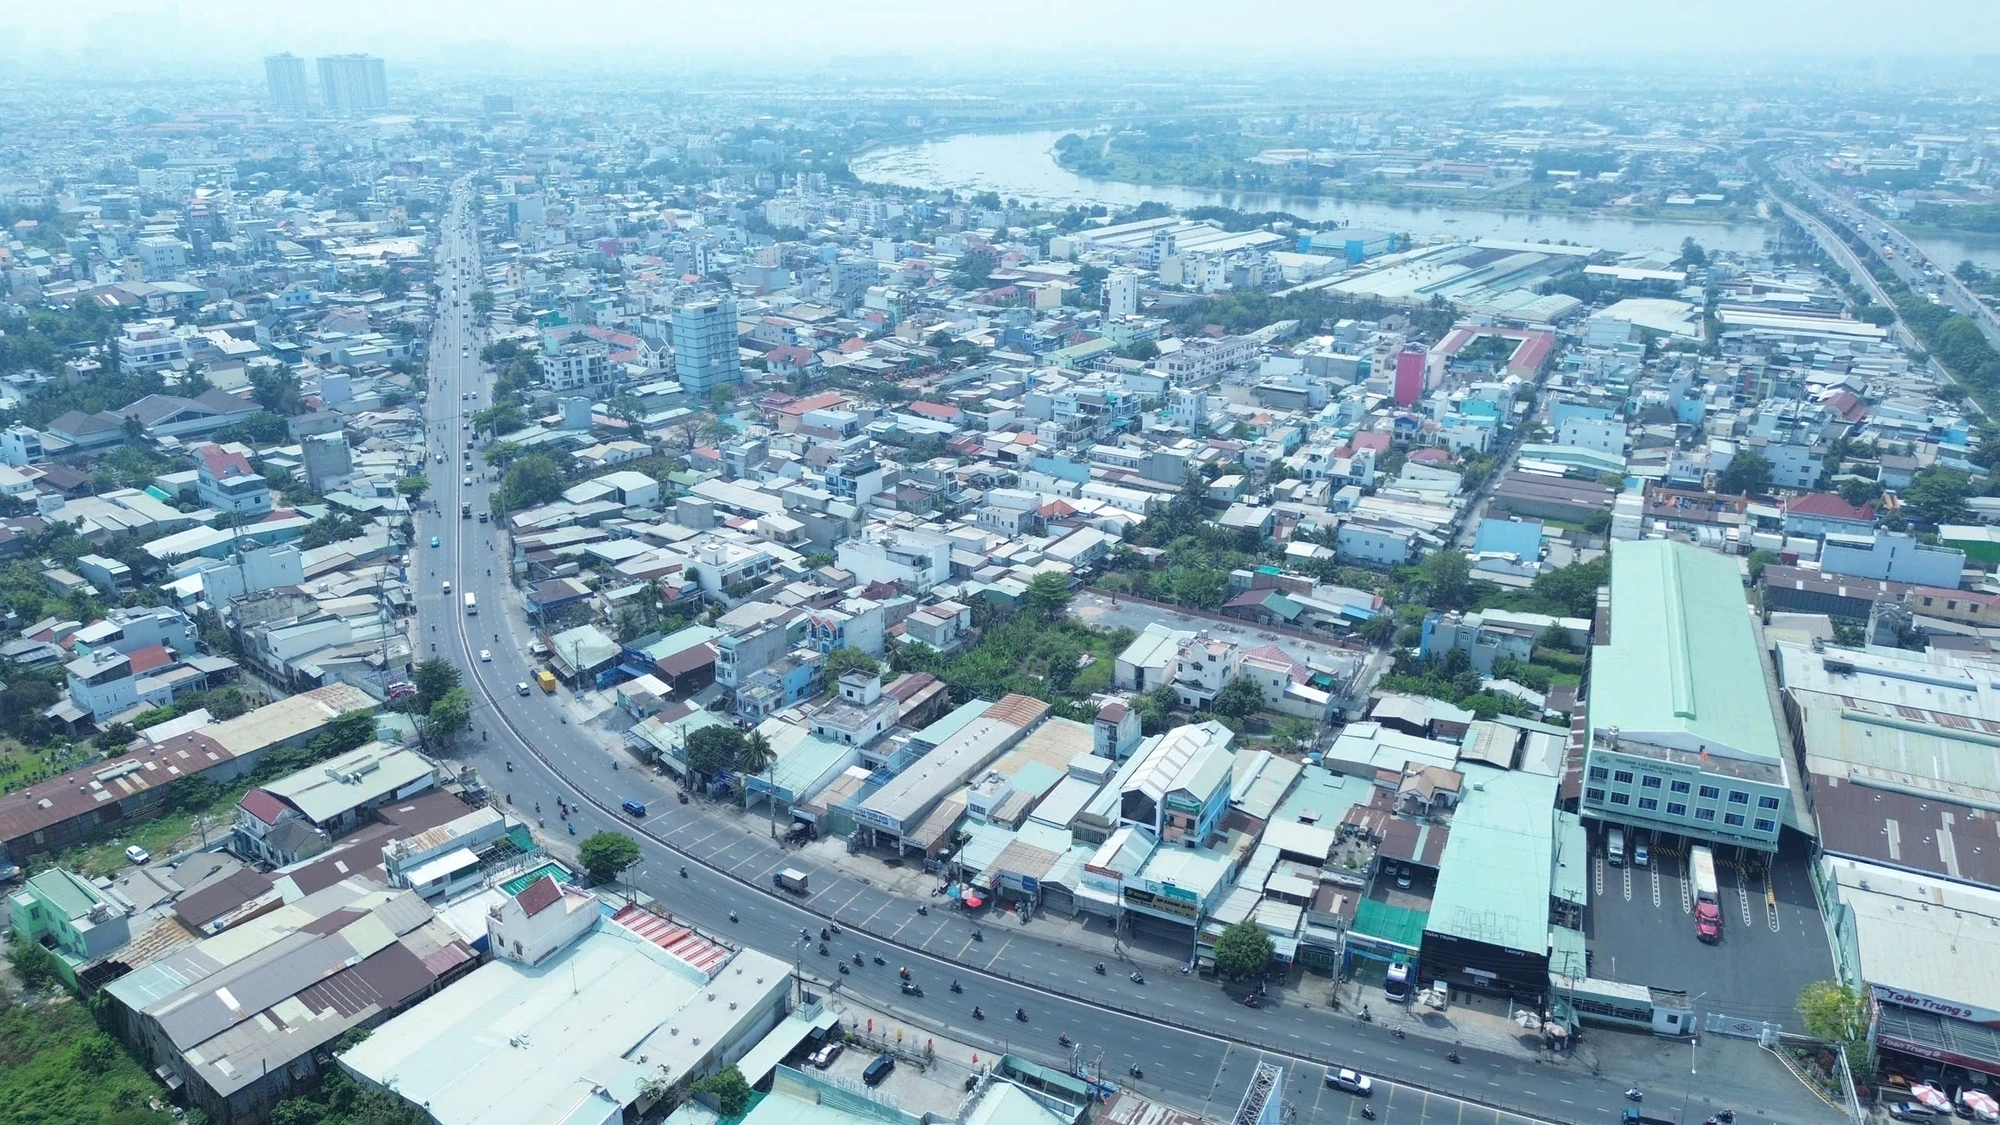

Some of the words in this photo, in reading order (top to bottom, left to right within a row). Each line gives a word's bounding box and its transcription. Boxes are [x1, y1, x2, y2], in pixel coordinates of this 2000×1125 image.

[1504, 947, 1525, 957] Luxury
[1888, 990, 1920, 1005] Toàn
[1922, 998, 1961, 1016] Trung
[1962, 1009, 1972, 1017] 9
[1905, 1044, 1932, 1056] Trung
